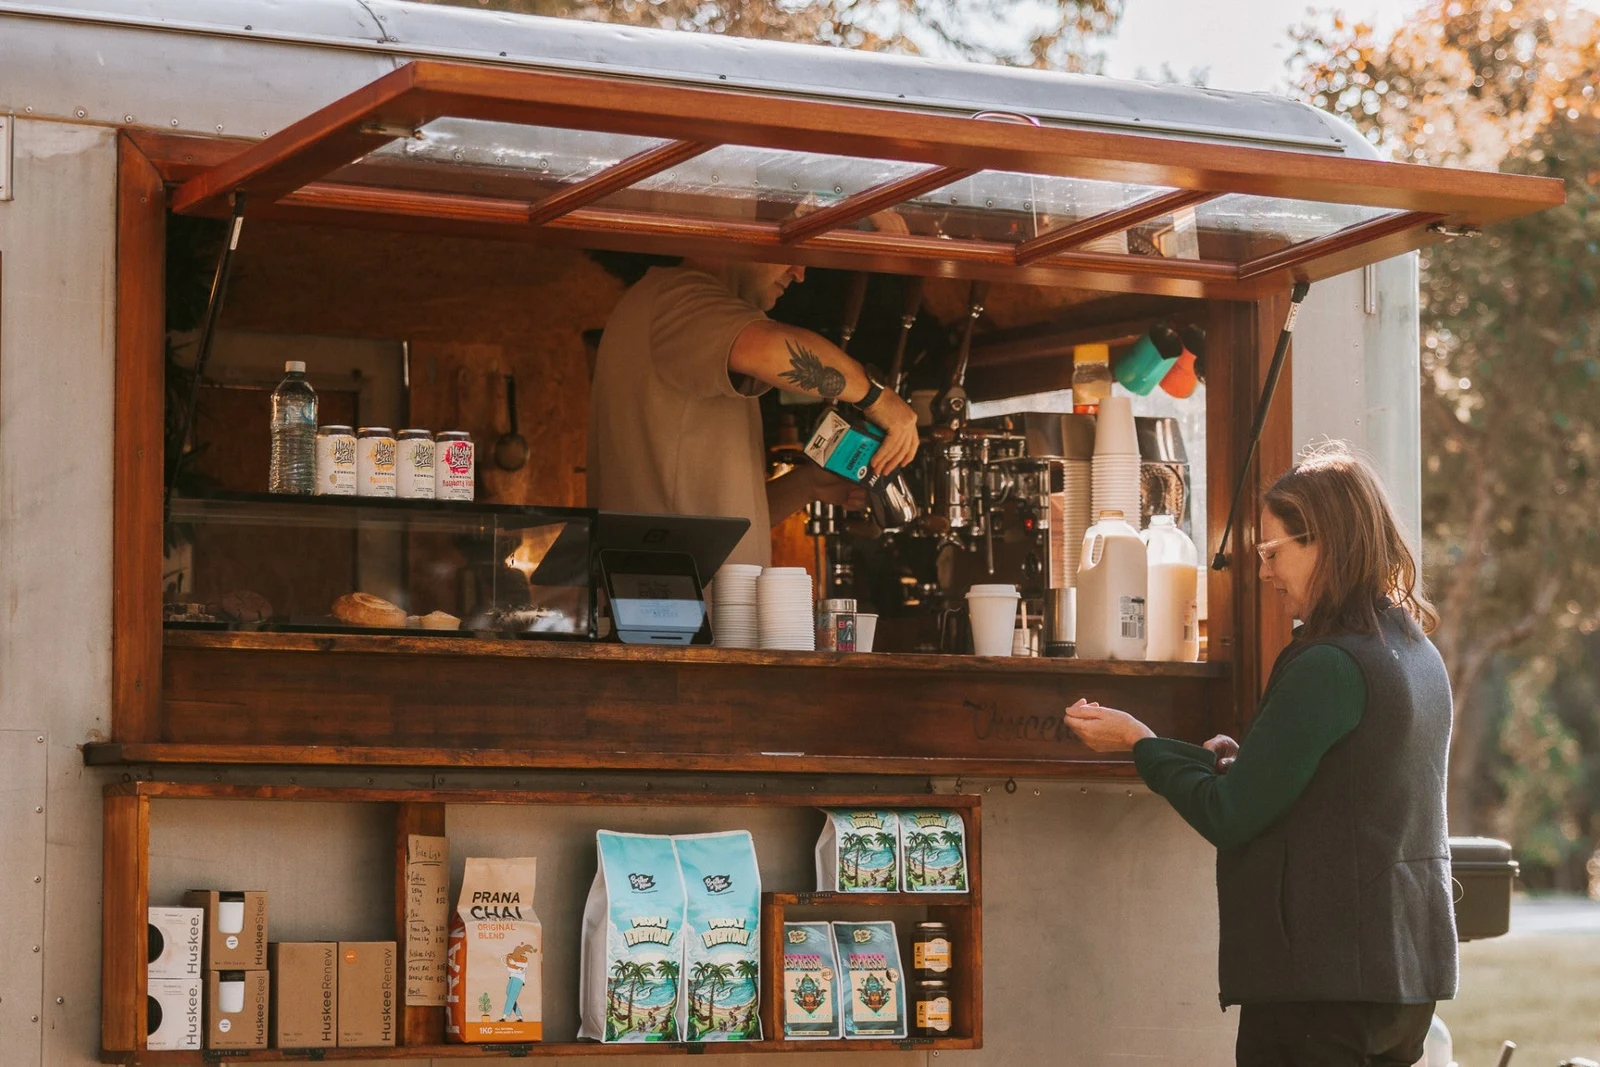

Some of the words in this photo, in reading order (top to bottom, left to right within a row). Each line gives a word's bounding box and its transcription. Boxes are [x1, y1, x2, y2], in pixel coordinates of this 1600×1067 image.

[470, 905, 523, 920] CHAI
[472, 892, 521, 904] PRANA
[187, 914, 200, 974] Huskee.
[255, 896, 264, 966] HuskeeSteel
[477, 923, 516, 931] ORIGINAL
[478, 932, 505, 940] BLEND
[624, 926, 674, 948] EVERYDAY
[702, 928, 751, 949] EVERYDAY
[186, 985, 198, 1045] Huskee.
[255, 976, 265, 1045] HuskeeSteel
[322, 948, 333, 1041] HuskeeRenew
[381, 948, 393, 1041] HuskeeRenew
